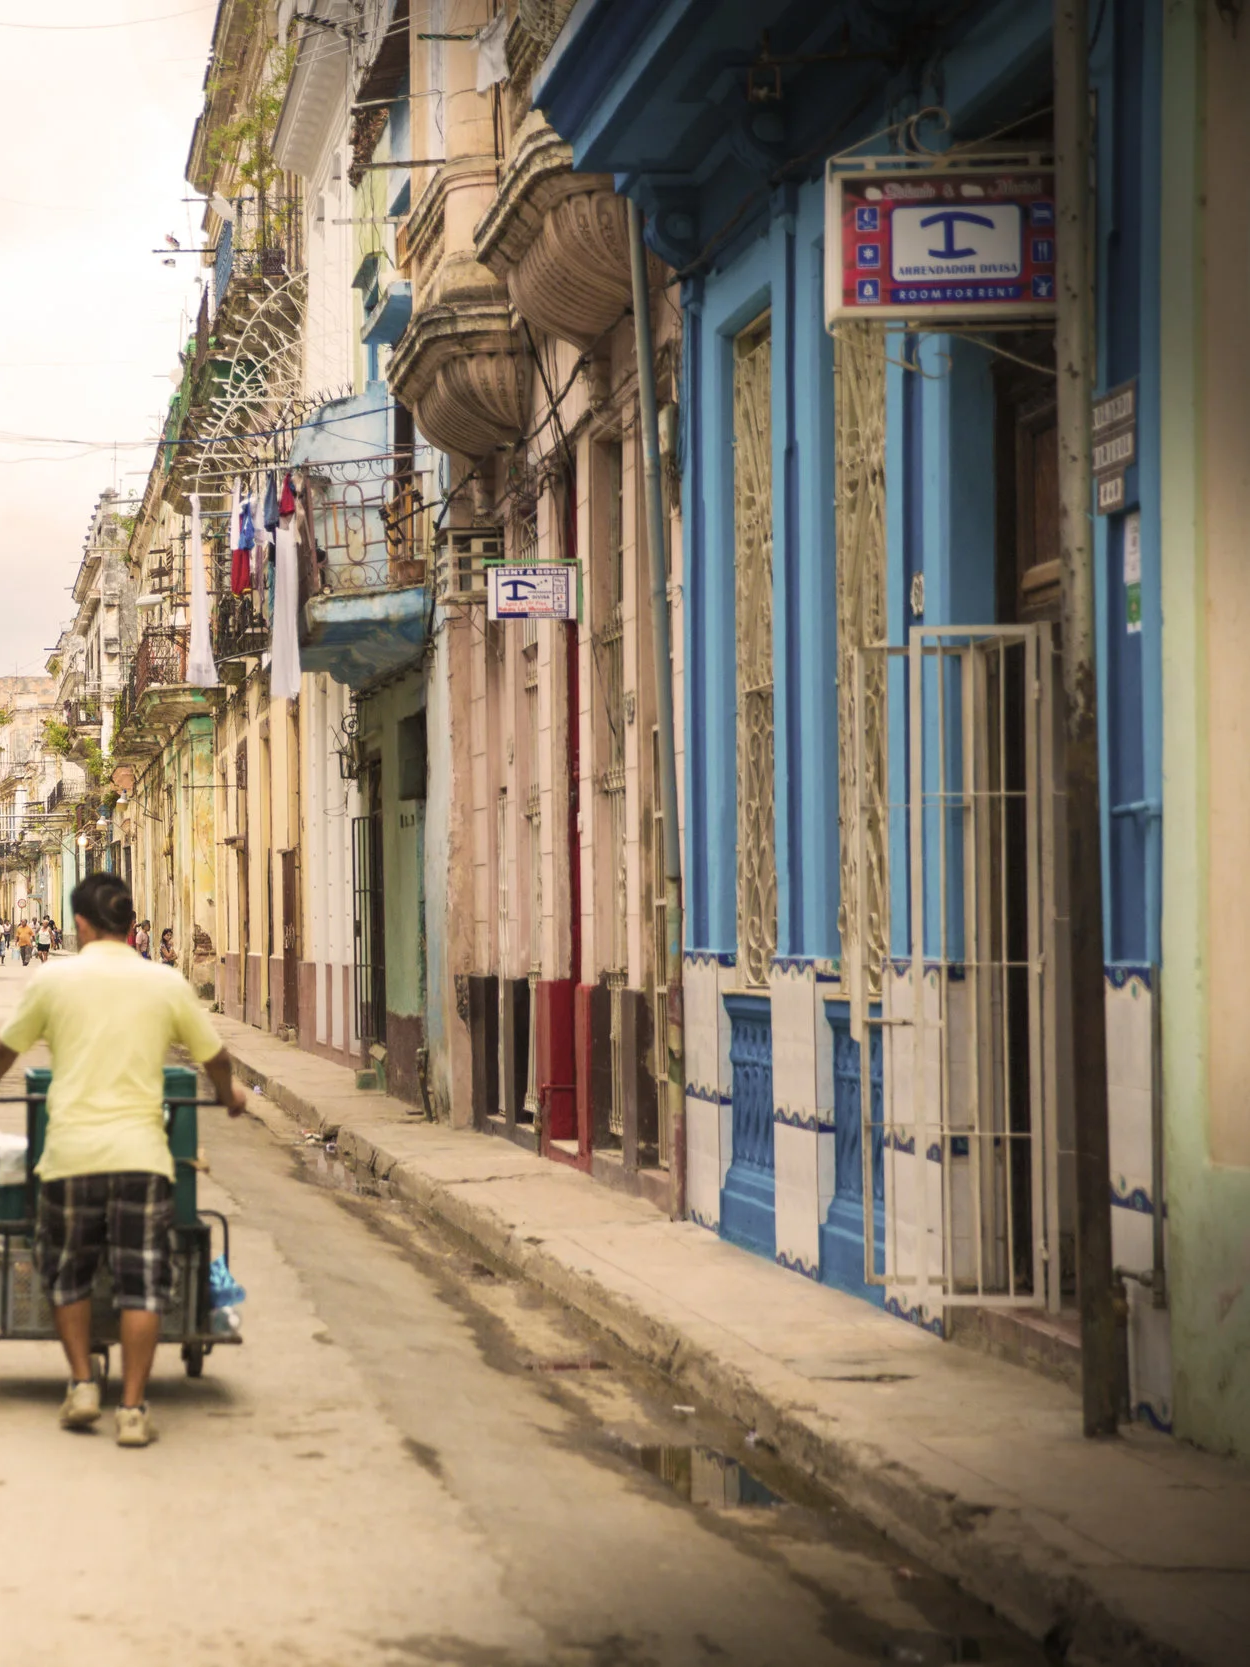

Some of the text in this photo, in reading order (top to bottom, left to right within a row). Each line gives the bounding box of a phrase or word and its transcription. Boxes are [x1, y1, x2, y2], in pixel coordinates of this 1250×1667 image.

[898, 262, 1019, 276] ARRENDADOR DIVISA
[899, 286, 1015, 300] ROOM FOR RENT
